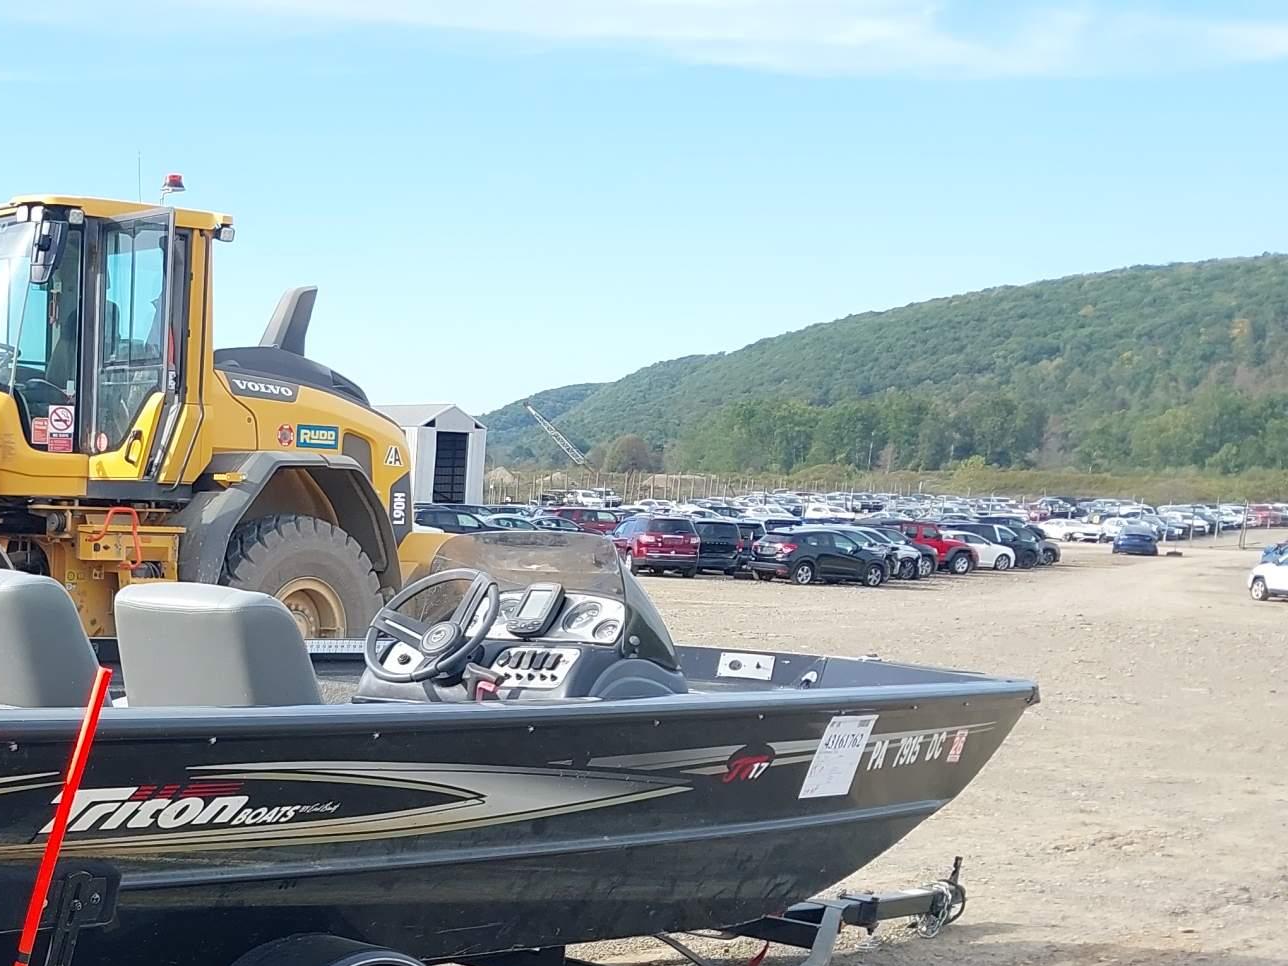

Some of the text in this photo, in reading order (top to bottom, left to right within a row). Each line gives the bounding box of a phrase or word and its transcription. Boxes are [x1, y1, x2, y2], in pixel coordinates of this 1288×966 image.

[231, 379, 293, 397] VOLVO
[299, 429, 336, 443] RUDD
[393, 492, 406, 525] L90H
[824, 733, 865, 750] 43161762
[866, 740, 889, 771] PA
[924, 731, 947, 761] DC
[233, 804, 299, 826] BOATS
